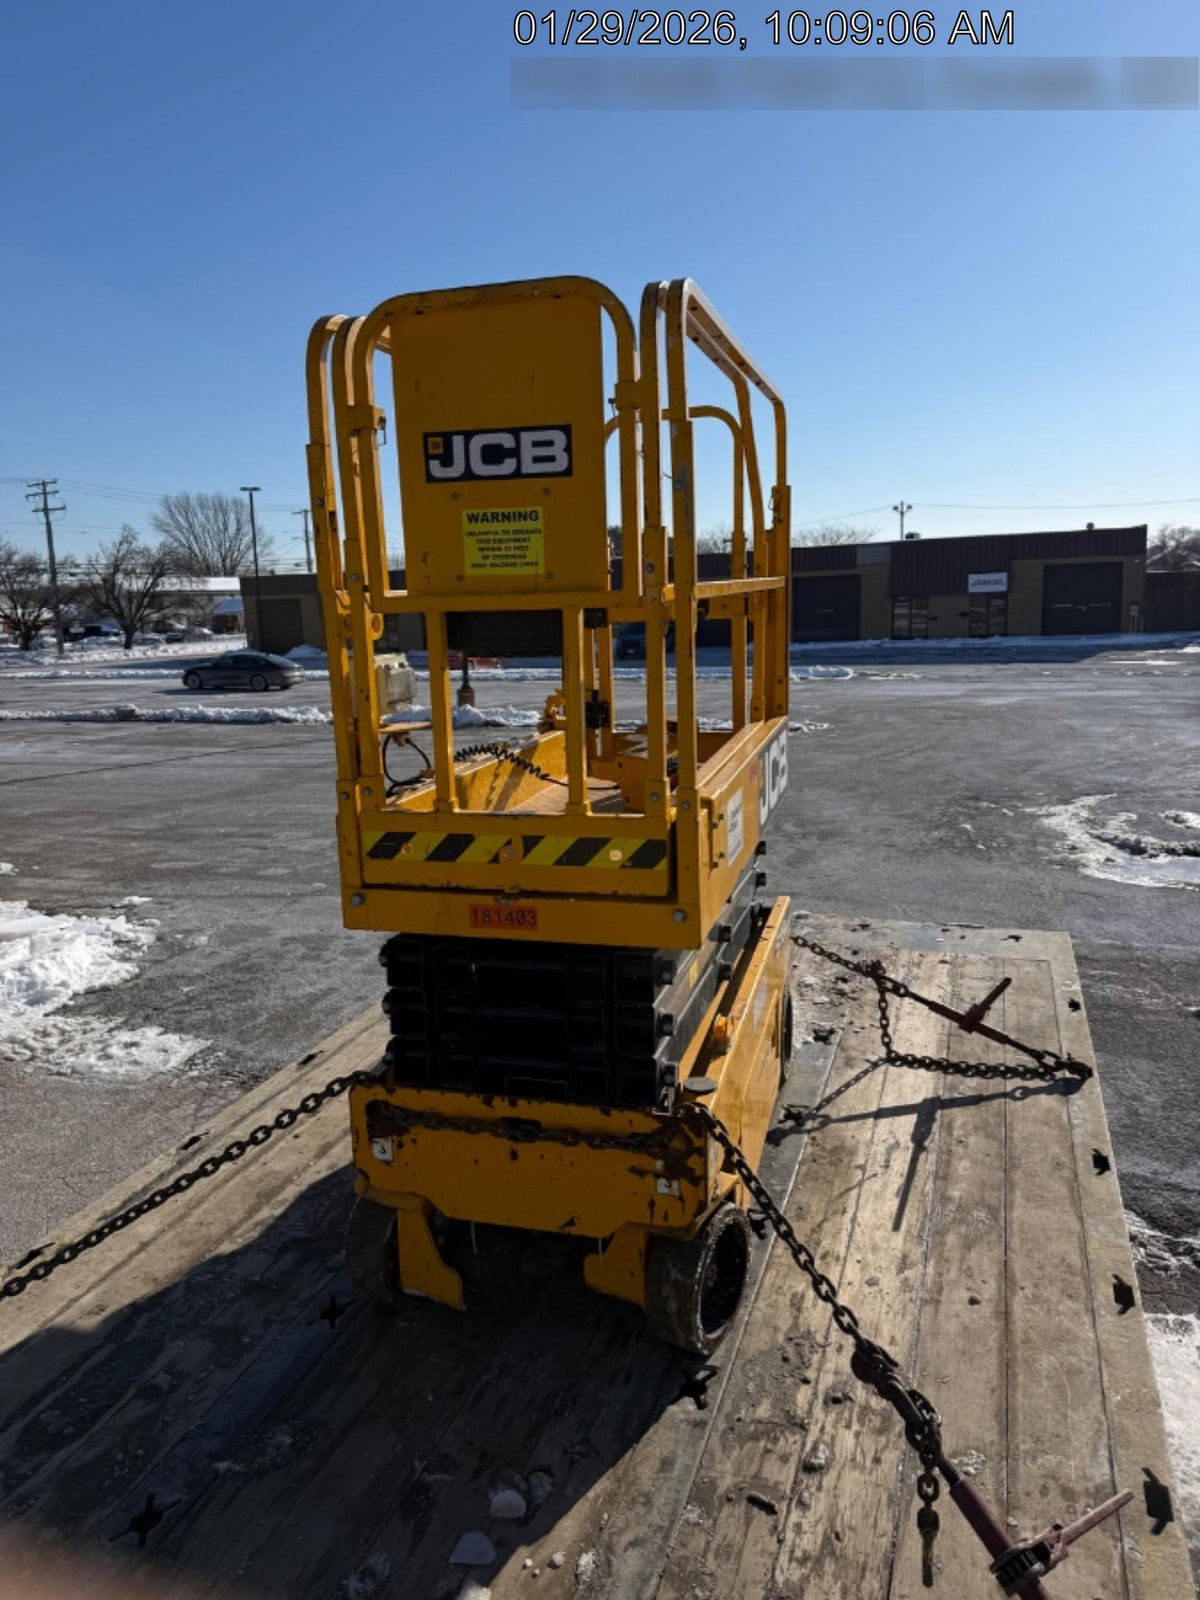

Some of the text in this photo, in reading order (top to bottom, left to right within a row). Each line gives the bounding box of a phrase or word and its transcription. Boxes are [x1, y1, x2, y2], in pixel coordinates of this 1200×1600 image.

[428, 430, 569, 479] JCB
[466, 509, 539, 524] WARNING
[471, 908, 538, 928] 181403
